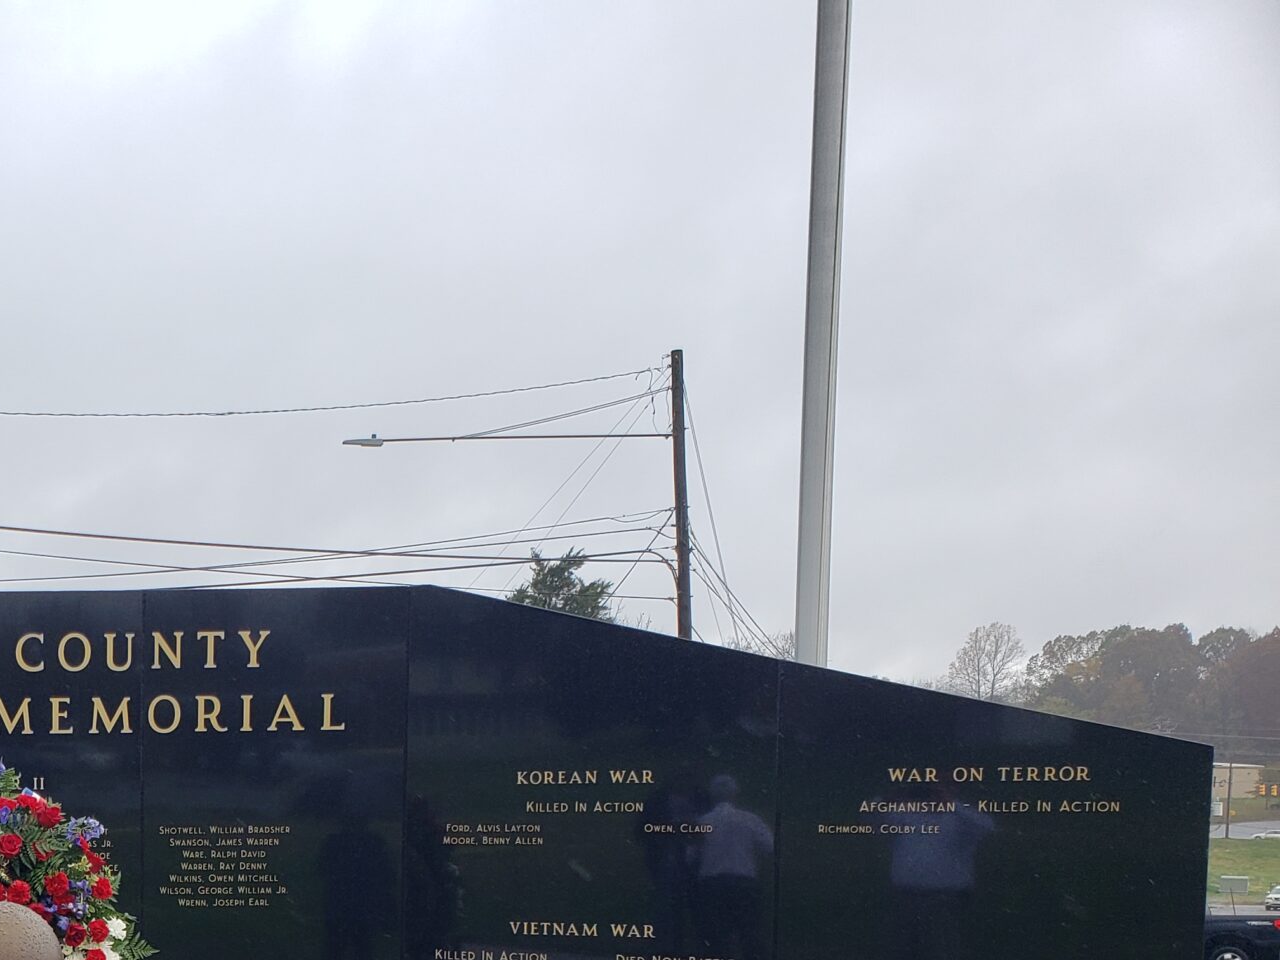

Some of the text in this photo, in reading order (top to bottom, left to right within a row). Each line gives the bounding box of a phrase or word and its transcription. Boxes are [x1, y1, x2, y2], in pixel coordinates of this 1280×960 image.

[16, 631, 270, 672] COUNTY
[517, 770, 653, 784] KOREAN WAR
[888, 766, 1090, 782] WAR ON TERROR
[33, 777, 45, 790] II
[527, 801, 643, 812] KILLED IN ACTION
[860, 801, 955, 812] AFGHANISTAN
[979, 800, 1028, 812] KILLED
[1037, 800, 1050, 811] IN
[1060, 800, 1119, 812] ACTION
[209, 825, 244, 834] WILLIAM
[247, 825, 290, 834] BRADSHER
[476, 823, 501, 833] ALVIS
[504, 823, 541, 833] LAYTON
[679, 823, 714, 833] CLAUD
[880, 824, 916, 834] COLBY
[921, 824, 940, 834] LEE
[215, 837, 243, 847] JAMES
[246, 837, 280, 846] WARREN
[482, 835, 511, 845] BENNY
[514, 836, 544, 845] ALLEN
[208, 873, 234, 883] OWEN
[237, 873, 279, 883] MITCHELL
[510, 922, 655, 938] VIETNAM WAR
[436, 949, 475, 960] KILLED
